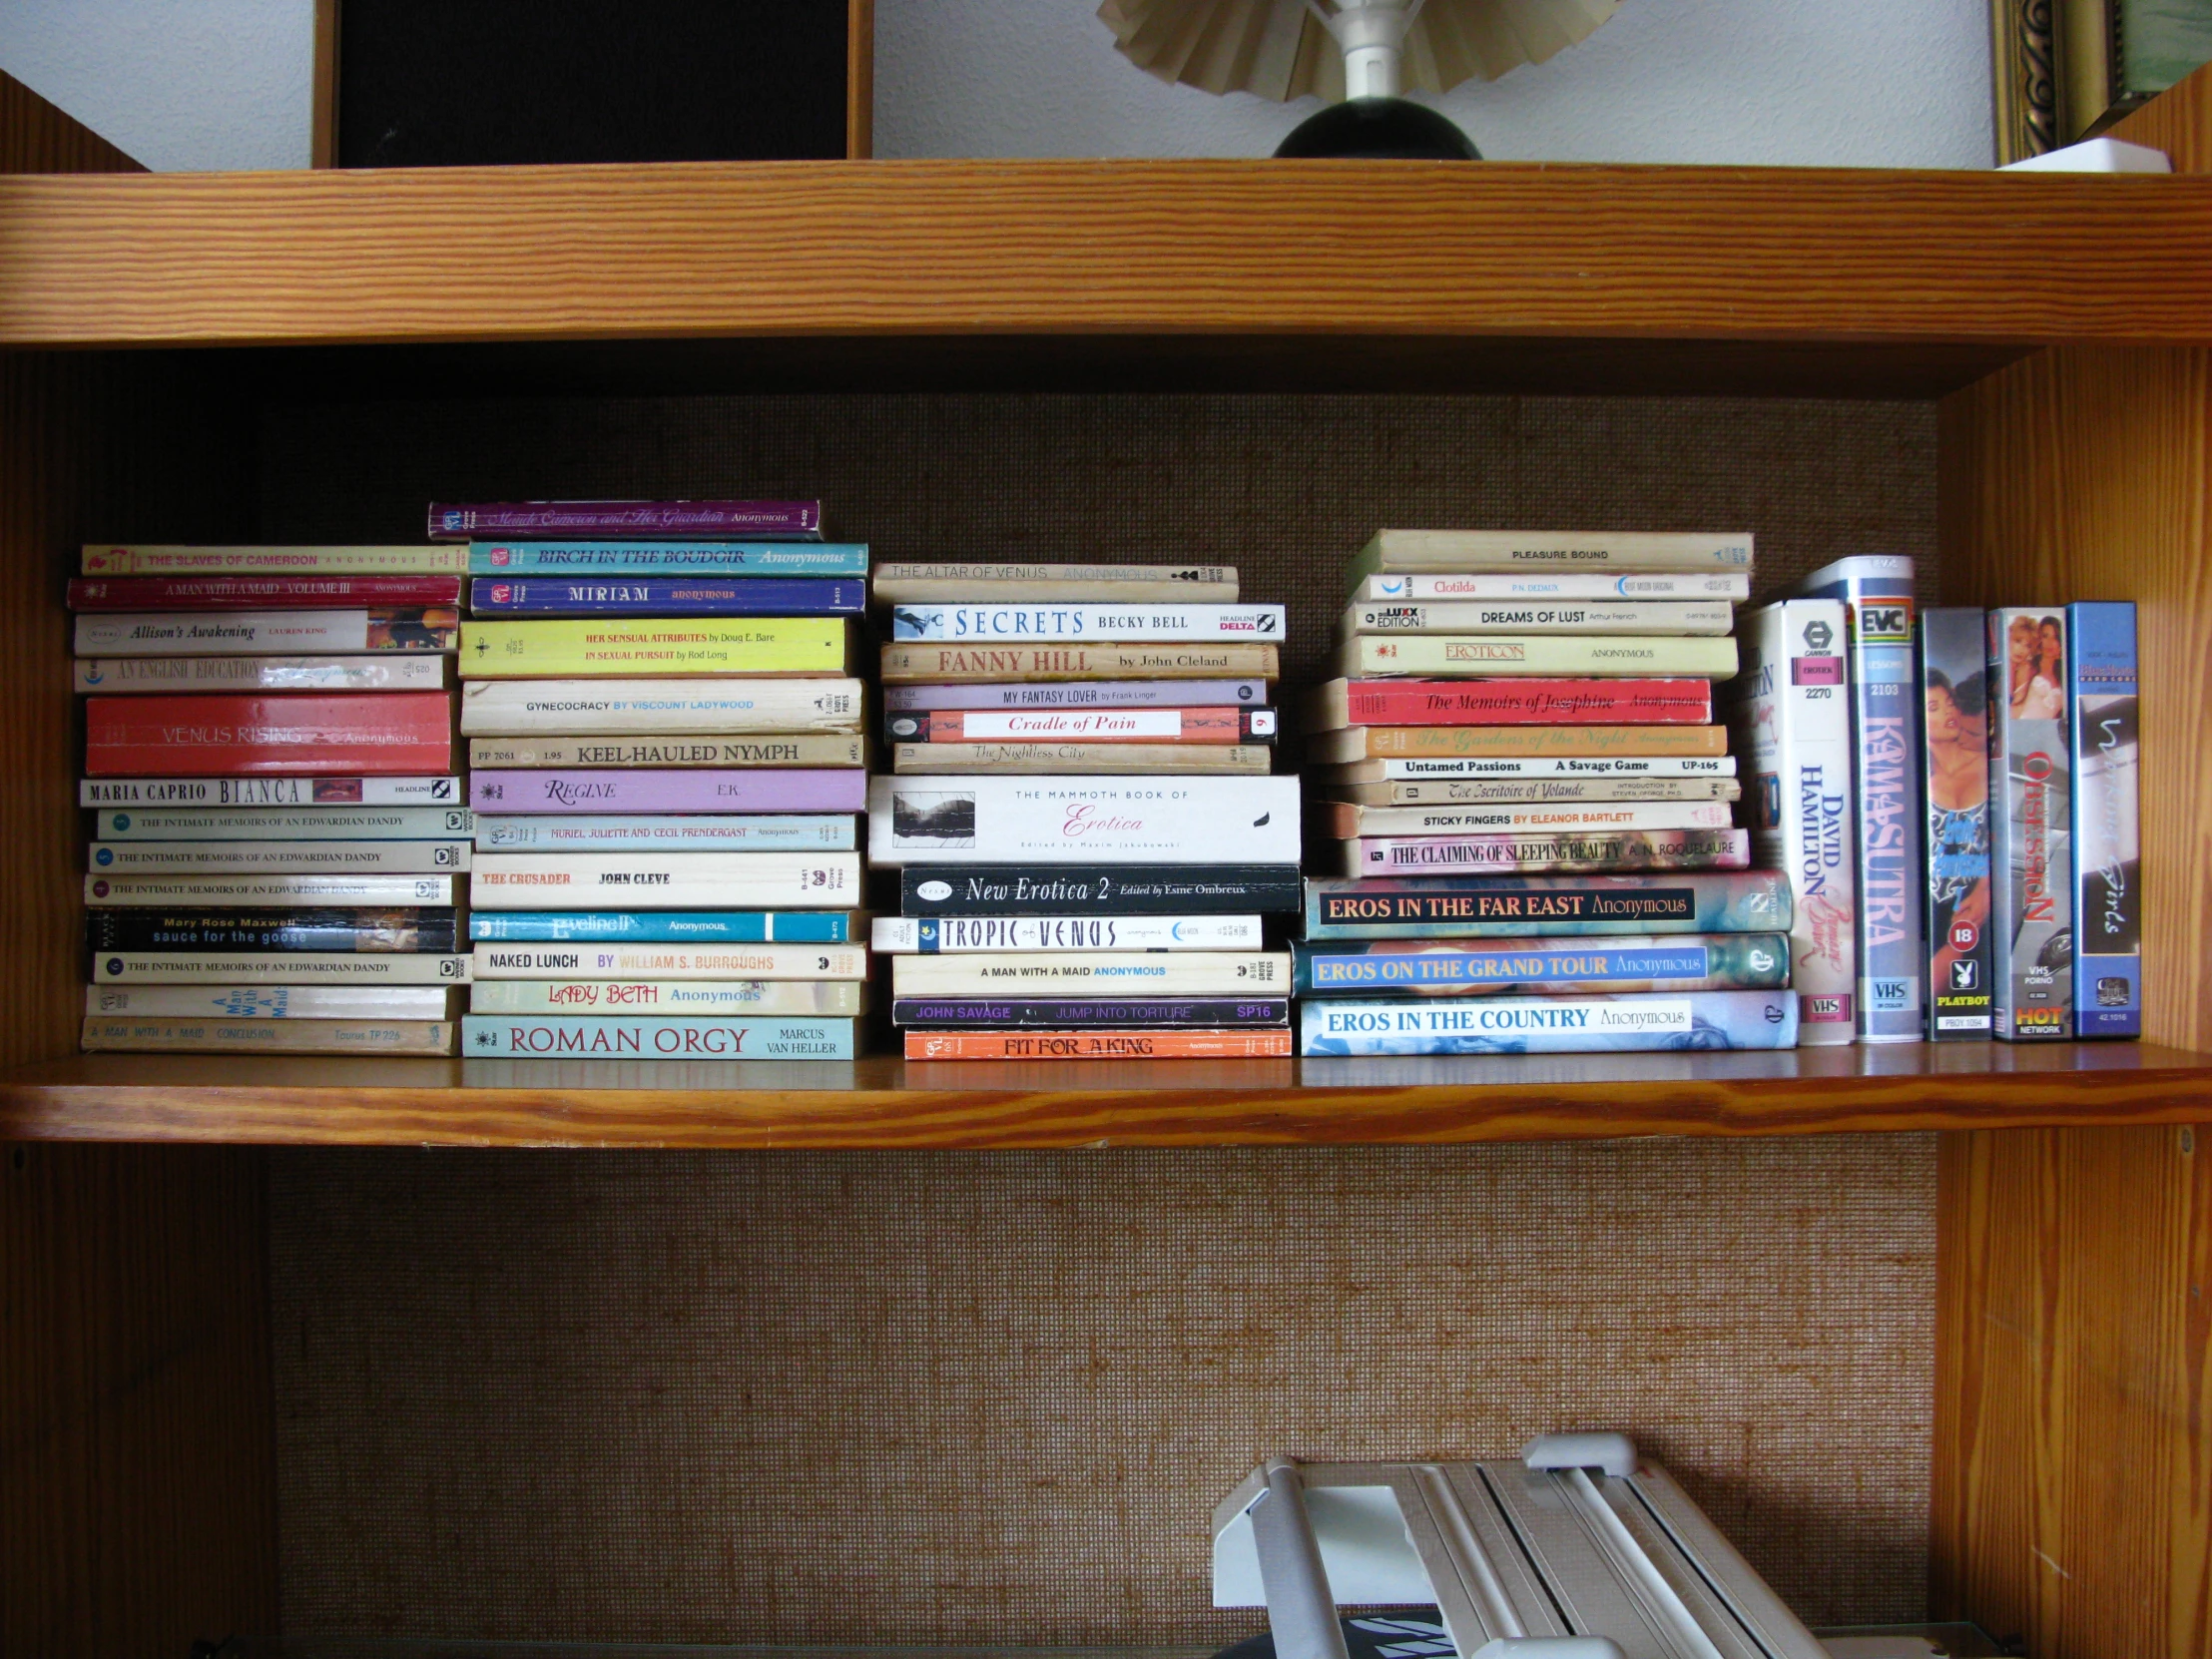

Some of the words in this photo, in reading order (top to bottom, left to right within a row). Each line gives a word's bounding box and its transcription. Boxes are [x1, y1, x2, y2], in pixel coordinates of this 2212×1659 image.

[149, 556, 173, 565] THE
[177, 556, 224, 565] SLAVES
[228, 556, 244, 565] OF
[247, 556, 317, 565] CAMEROON
[538, 549, 583, 564] BIRCH
[587, 550, 609, 564] IN
[613, 550, 652, 564] THE
[656, 550, 746, 564] BOUDOIR
[758, 550, 845, 564] Anonymous
[569, 587, 649, 601] MIRIAM
[672, 590, 736, 599] anonymous
[1434, 582, 1475, 593] Clotilda
[955, 609, 1084, 637] SECRETS
[1098, 617, 1147, 628] BECKY
[1153, 616, 1188, 628] BELL
[1379, 617, 1419, 628] EDITION
[1481, 611, 1533, 623] DREAMS
[1537, 611, 1555, 623] OF
[1559, 611, 1584, 622] LUST
[1863, 610, 1907, 631] EVC
[131, 625, 184, 639] Allison's
[187, 625, 256, 641] Awakening
[1446, 644, 1525, 660] EROTICON
[939, 651, 1023, 671] FANNY
[1034, 651, 1092, 671] HILL
[1120, 656, 1135, 667] by
[1140, 655, 1172, 666] John
[1177, 655, 1228, 667] Cleland
[1806, 689, 1832, 699] 2270
[1871, 685, 1899, 695] 2103
[1008, 717, 1067, 731] Cradle
[1073, 716, 1087, 732] of
[1094, 716, 1136, 731] Pain
[544, 751, 562, 760] 1.95
[578, 747, 718, 764] KEEL-HAULED
[724, 745, 799, 761] NYMPH
[1405, 762, 1465, 772] Untamed
[1469, 762, 1521, 772] Passions
[1556, 761, 1565, 771] A
[1569, 761, 1611, 773] Savage
[1614, 761, 1649, 771] Game
[1682, 761, 1719, 770] UP-165
[90, 785, 139, 801] MARIA
[148, 785, 206, 800] CAPRIO
[220, 780, 299, 803] BIANCA
[1063, 804, 1143, 836] Erotica
[1423, 817, 1462, 826] STICKY
[1465, 816, 1511, 826] FINGERS
[1514, 815, 1528, 824] BY
[1582, 813, 1633, 823] BARTLETT
[1800, 765, 1826, 895] HAMILTON
[1823, 795, 1844, 867] DAVID
[1865, 717, 1907, 946] KAMASUTRA
[2023, 751, 2054, 923] OBSESSION
[141, 853, 193, 862] INTIMATE
[196, 853, 243, 862] MEMOIRS
[345, 853, 381, 862] DANDY
[1391, 844, 1418, 863] THE
[1421, 843, 1483, 862] CLAIMING
[1487, 843, 1502, 861] OF
[1505, 841, 1566, 861] SLEEPING
[1570, 840, 1620, 859] BEAUTY
[483, 874, 505, 884] THE
[509, 873, 570, 884] CRUSADER
[599, 874, 630, 884] JOHN
[634, 873, 670, 884] CLEVE
[966, 878, 1008, 901] New
[1015, 878, 1088, 899] Erotica
[1097, 877, 1109, 899] 2
[1329, 899, 1391, 918] EROS
[1396, 900, 1421, 916] IN
[1425, 898, 1473, 916] THE
[1478, 898, 1522, 915] FAR
[1526, 897, 1583, 914] EAST
[1592, 895, 1687, 919] Anonymous
[669, 921, 726, 931] Anonymous
[154, 932, 197, 942] sauce
[204, 931, 226, 942] for
[233, 931, 256, 942] the
[262, 932, 306, 944] goose
[1955, 930, 1971, 941] 18
[490, 954, 532, 968] NAKED
[536, 954, 578, 968] LUNCH
[598, 955, 614, 968] BY
[620, 955, 674, 969] WILLIAM
[679, 956, 691, 969] S.
[696, 956, 774, 970] BURROUGHS
[2029, 966, 2048, 975] VHS
[1876, 982, 1905, 998] VHS
[1813, 999, 1839, 1011] VHS
[1937, 996, 1989, 1006] PLAYBOY
[916, 1007, 954, 1018] JOHN
[957, 1007, 1011, 1018] SAVAGE
[1056, 1007, 1092, 1018] JUMP
[1096, 1007, 1126, 1018] INTO
[1130, 1007, 1191, 1018] TORTURE
[1237, 1006, 1271, 1017] SP16
[2016, 1008, 2062, 1024] HOT
[1329, 1013, 1389, 1032] EROS
[1397, 1013, 1421, 1029] IN
[1425, 1012, 1473, 1029] THE
[1480, 1009, 1589, 1029] COUNTRY
[1600, 1009, 1685, 1029] Anonymous
[1945, 1018, 1963, 1028] PBOY
[510, 1027, 641, 1053] ROMAN
[654, 1027, 750, 1054] ORGY
[780, 1029, 825, 1040] MARCUS
[767, 1043, 788, 1054] VAN
[792, 1043, 836, 1054] HELLER
